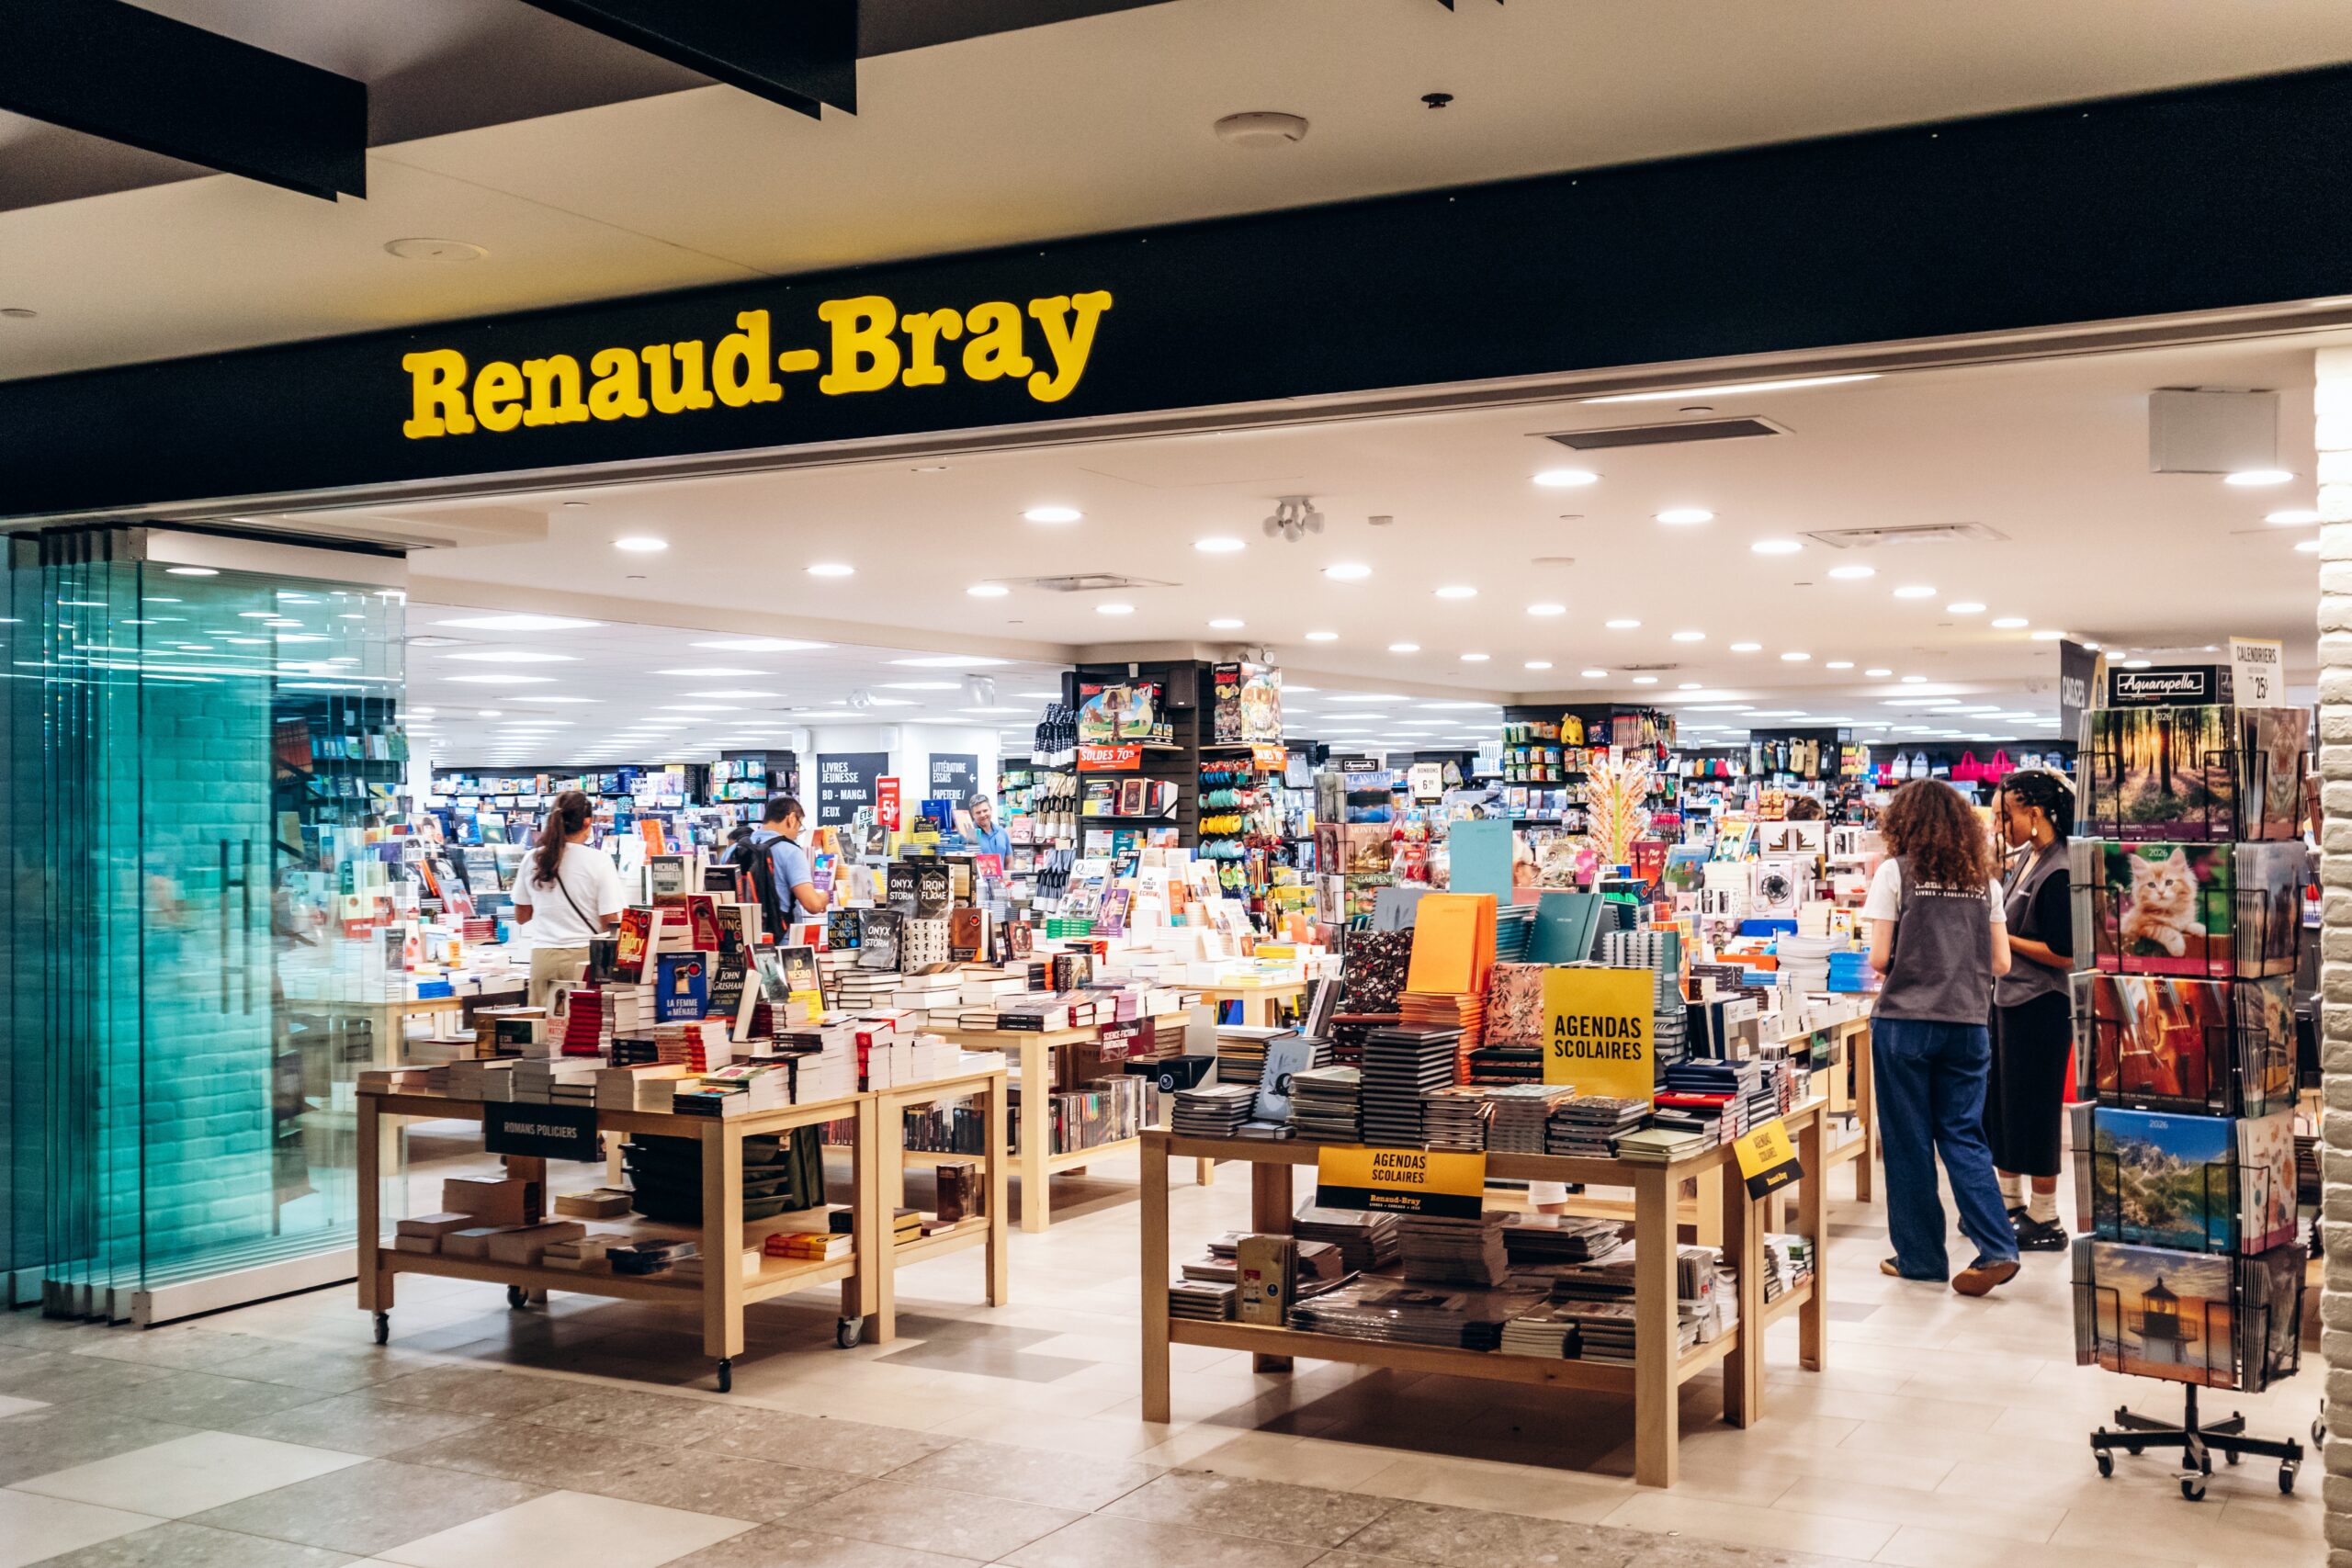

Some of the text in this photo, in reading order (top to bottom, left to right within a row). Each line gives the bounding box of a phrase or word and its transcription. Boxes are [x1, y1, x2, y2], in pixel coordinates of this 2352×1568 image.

[402, 289, 1114, 440] Renaud-Bray
[2236, 645, 2277, 664] CALENDRIERS
[2062, 675, 2086, 708] CAISSES
[2256, 676, 2268, 699] 25$
[2154, 713, 2172, 721] 2026
[1081, 750, 1135, 761] SOLDES 70%
[822, 761, 849, 773] LIVRES
[933, 760, 967, 773] LITTÉRATURE
[821, 772, 859, 784] JEUNESSE
[933, 773, 952, 784] ESSAIS
[1351, 773, 1387, 784] CANADA
[822, 789, 833, 800] BD
[840, 789, 867, 800] MANGA
[933, 789, 960, 800] PAPETERIE
[821, 807, 841, 818] JEUX
[2149, 848, 2168, 857] 2026
[653, 863, 680, 872] MICHAEL
[653, 871, 684, 881] CONNELLY
[890, 879, 913, 889] ONYX
[922, 880, 945, 888] IRON
[889, 891, 914, 900] STORM
[921, 891, 947, 900] FLAME
[718, 919, 742, 931] KING
[867, 925, 891, 936] ONYX
[865, 938, 889, 948] STORM
[793, 959, 803, 969] JO
[720, 970, 741, 982] JOHN
[712, 981, 744, 991] GRISHAM
[2150, 985, 2168, 993] 026
[666, 998, 698, 1008] LA FEMME
[673, 1007, 698, 1017] MÉNAGE
[1555, 1015, 1642, 1039] AGENDAS
[1555, 1039, 1642, 1060] SCOLAIRES
[2149, 1120, 2168, 1129] 2026
[504, 1122, 578, 1139] ROMANS POLICIERS
[1374, 1153, 1426, 1169] AGENDAS
[1372, 1168, 1425, 1184] SCOLAIRES
[1370, 1194, 1421, 1206] Renaud-Bray
